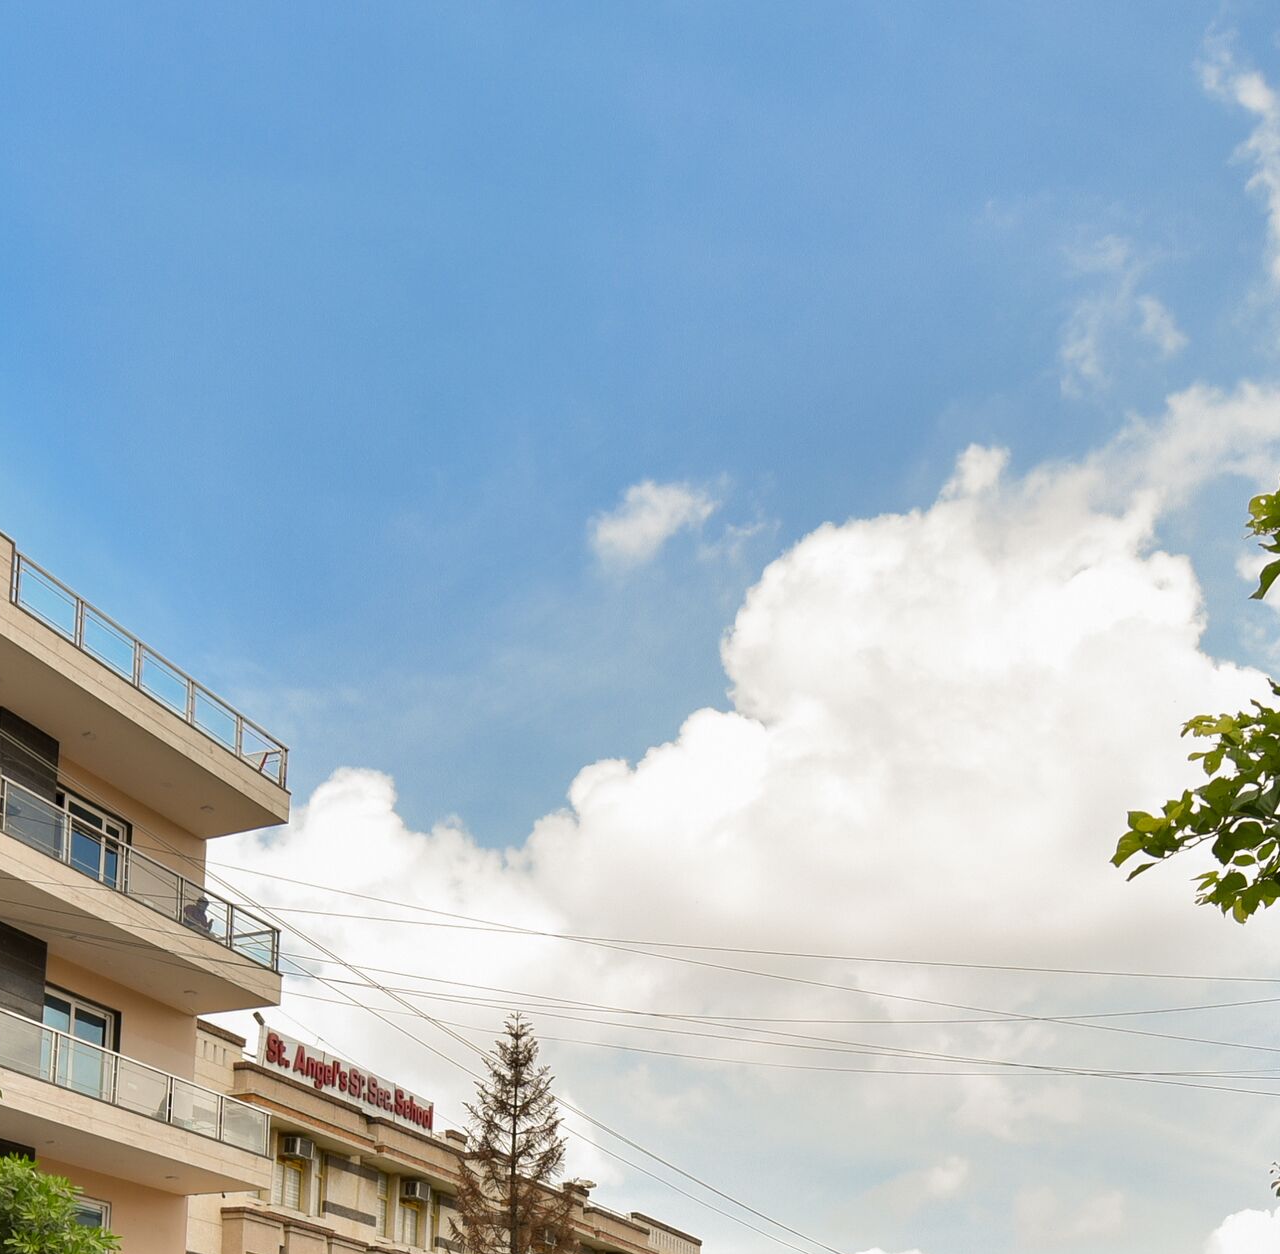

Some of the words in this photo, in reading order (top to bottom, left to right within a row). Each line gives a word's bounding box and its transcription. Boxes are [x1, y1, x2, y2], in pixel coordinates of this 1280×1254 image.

[266, 1032, 290, 1068] St.
[293, 1045, 348, 1090] Angel's
[394, 1088, 434, 1130] School
